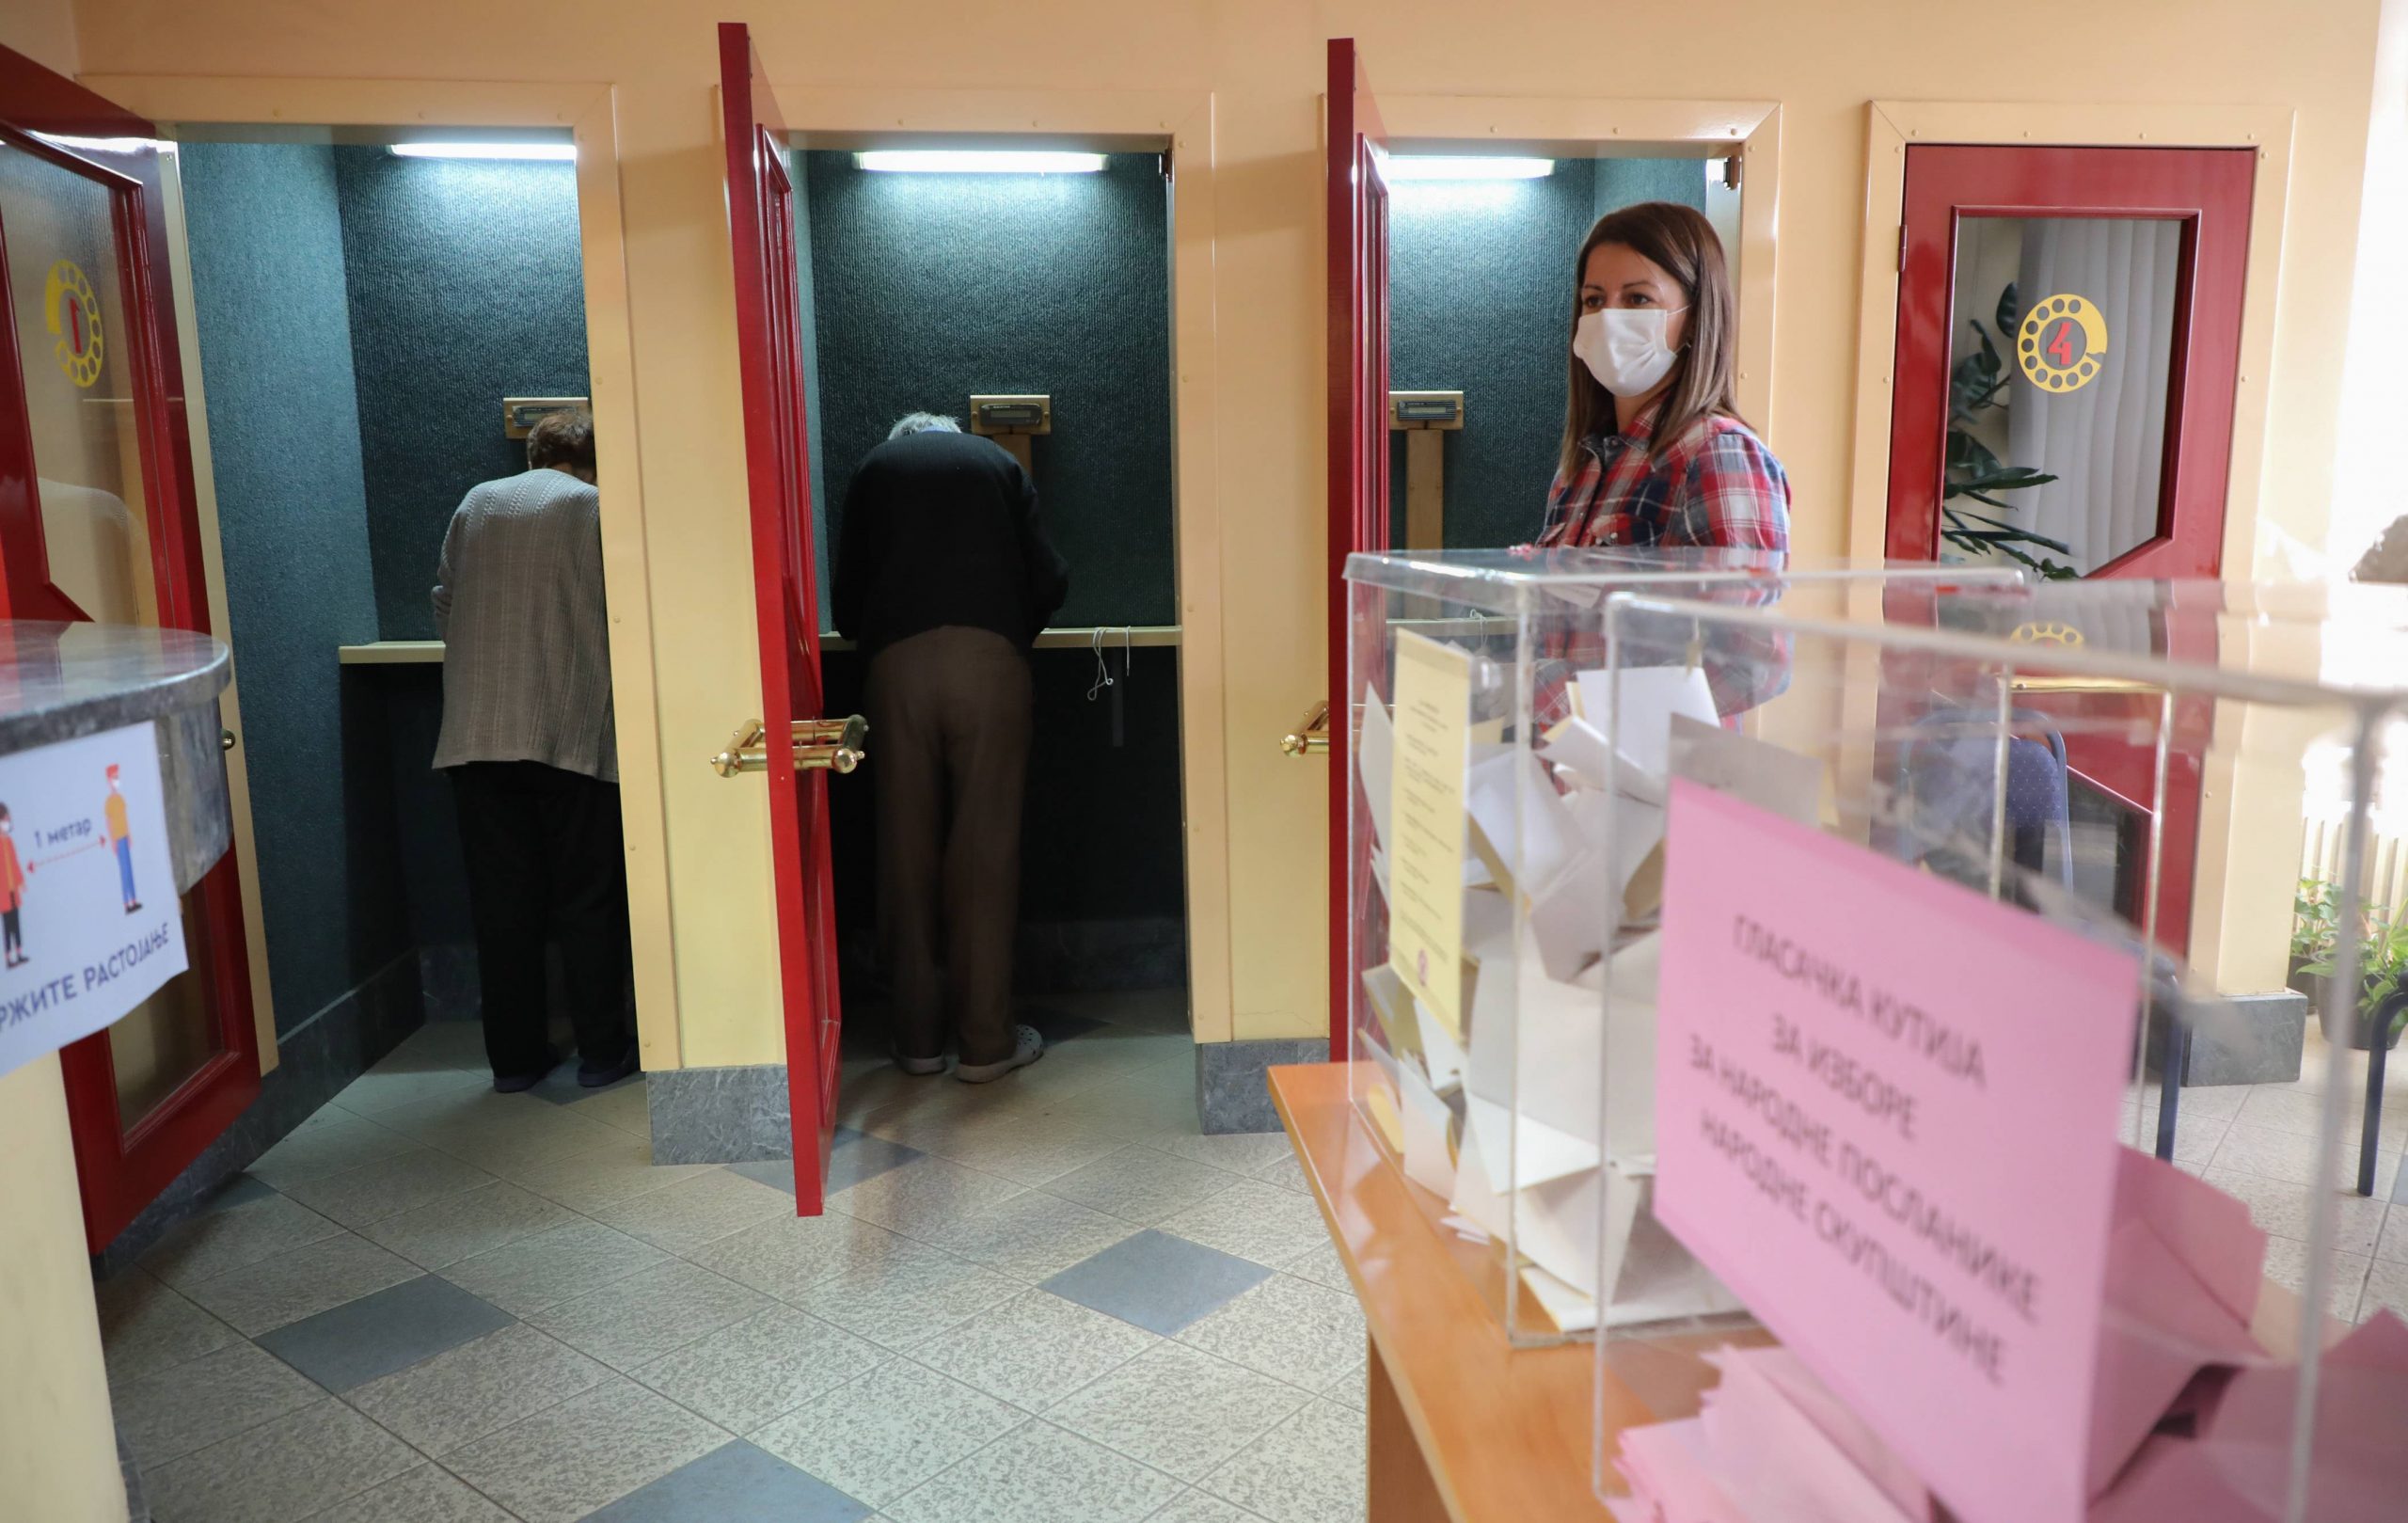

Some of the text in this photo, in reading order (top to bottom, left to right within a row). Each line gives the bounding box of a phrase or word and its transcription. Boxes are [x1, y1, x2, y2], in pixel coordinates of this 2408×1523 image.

[2048, 322, 2072, 365] 4
[34, 817, 91, 849] 1 метар
[83, 922, 168, 992] РАСТОЈАЊЕ
[1733, 913, 1988, 1091] ГЛАСАЧКА КУТИЈА
[1772, 1011, 1917, 1142] ЗА ИЗБОРЕ
[1689, 1032, 2041, 1325] ЗА НАРОДНЕ ПОСЛАНИКЕ
[1700, 1107, 2007, 1387] НАРОДНЕ СКУПШТИНЕ
